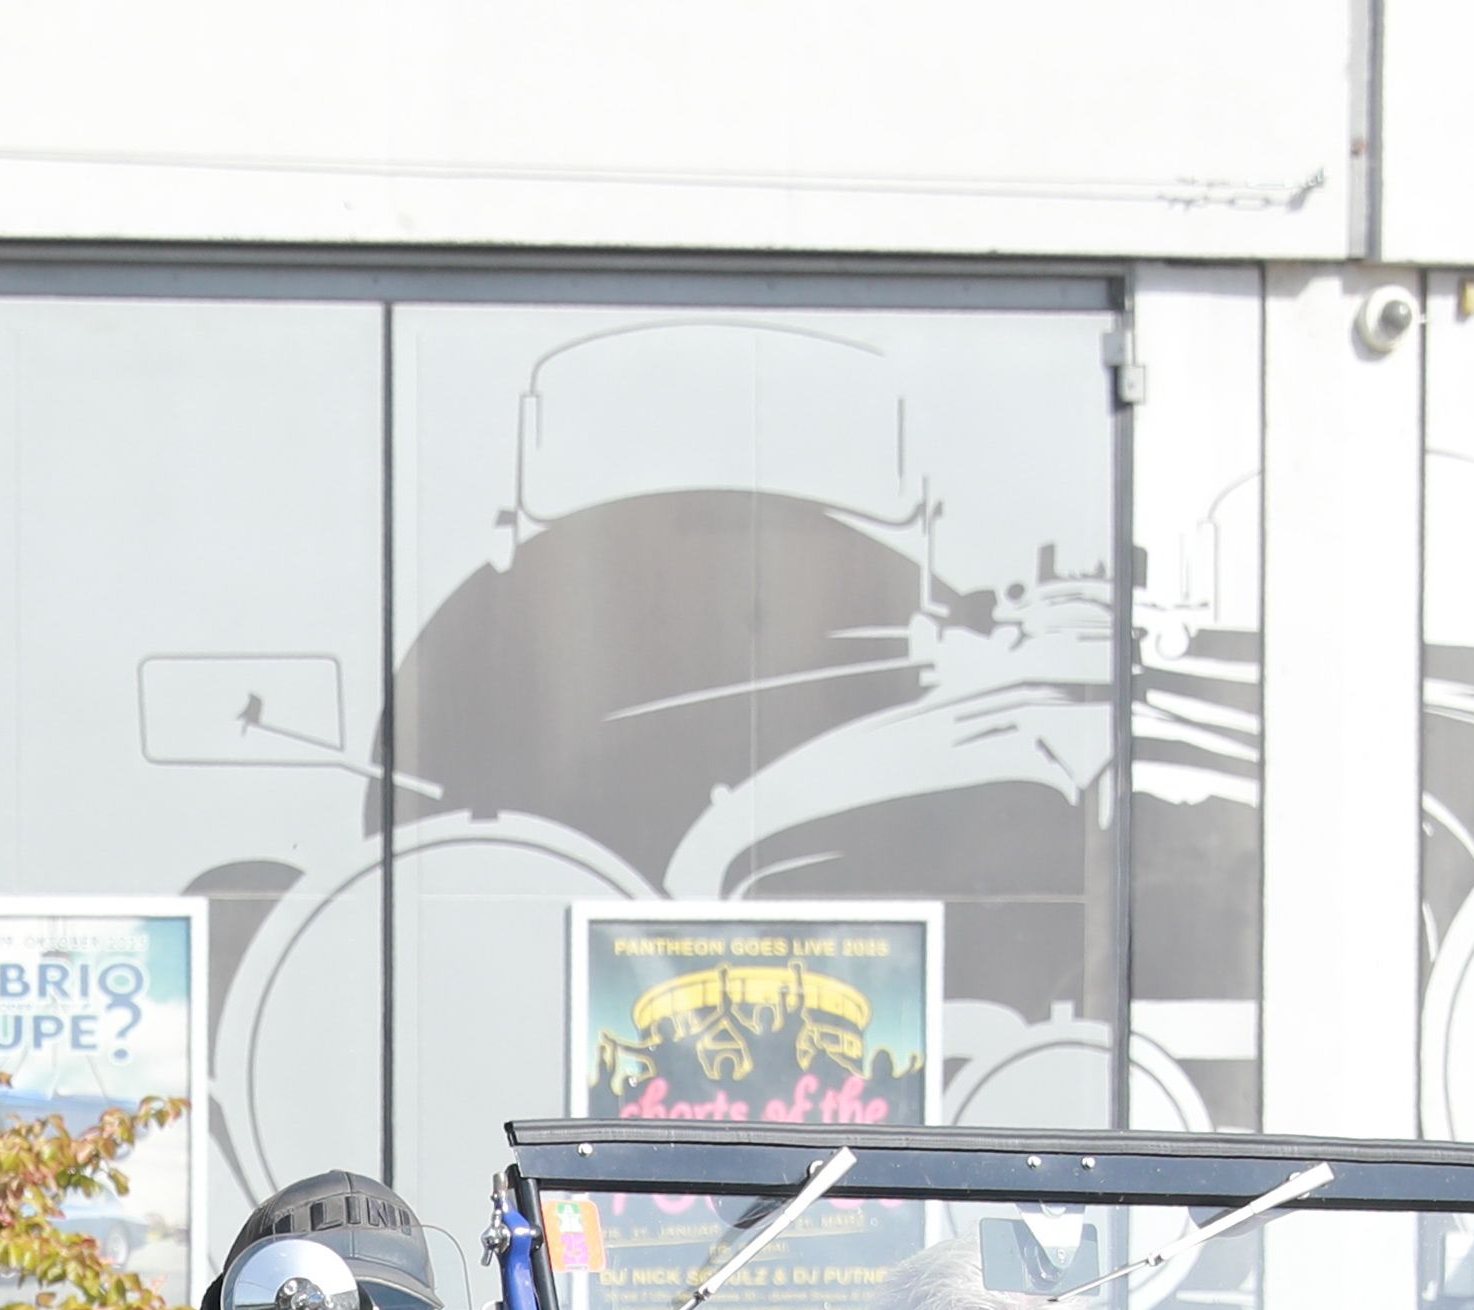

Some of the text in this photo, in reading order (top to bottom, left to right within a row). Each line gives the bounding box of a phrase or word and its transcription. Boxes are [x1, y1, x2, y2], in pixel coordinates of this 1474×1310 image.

[613, 937, 727, 957] PANTHEON
[730, 937, 789, 957] GOES
[792, 937, 837, 957] LIVE
